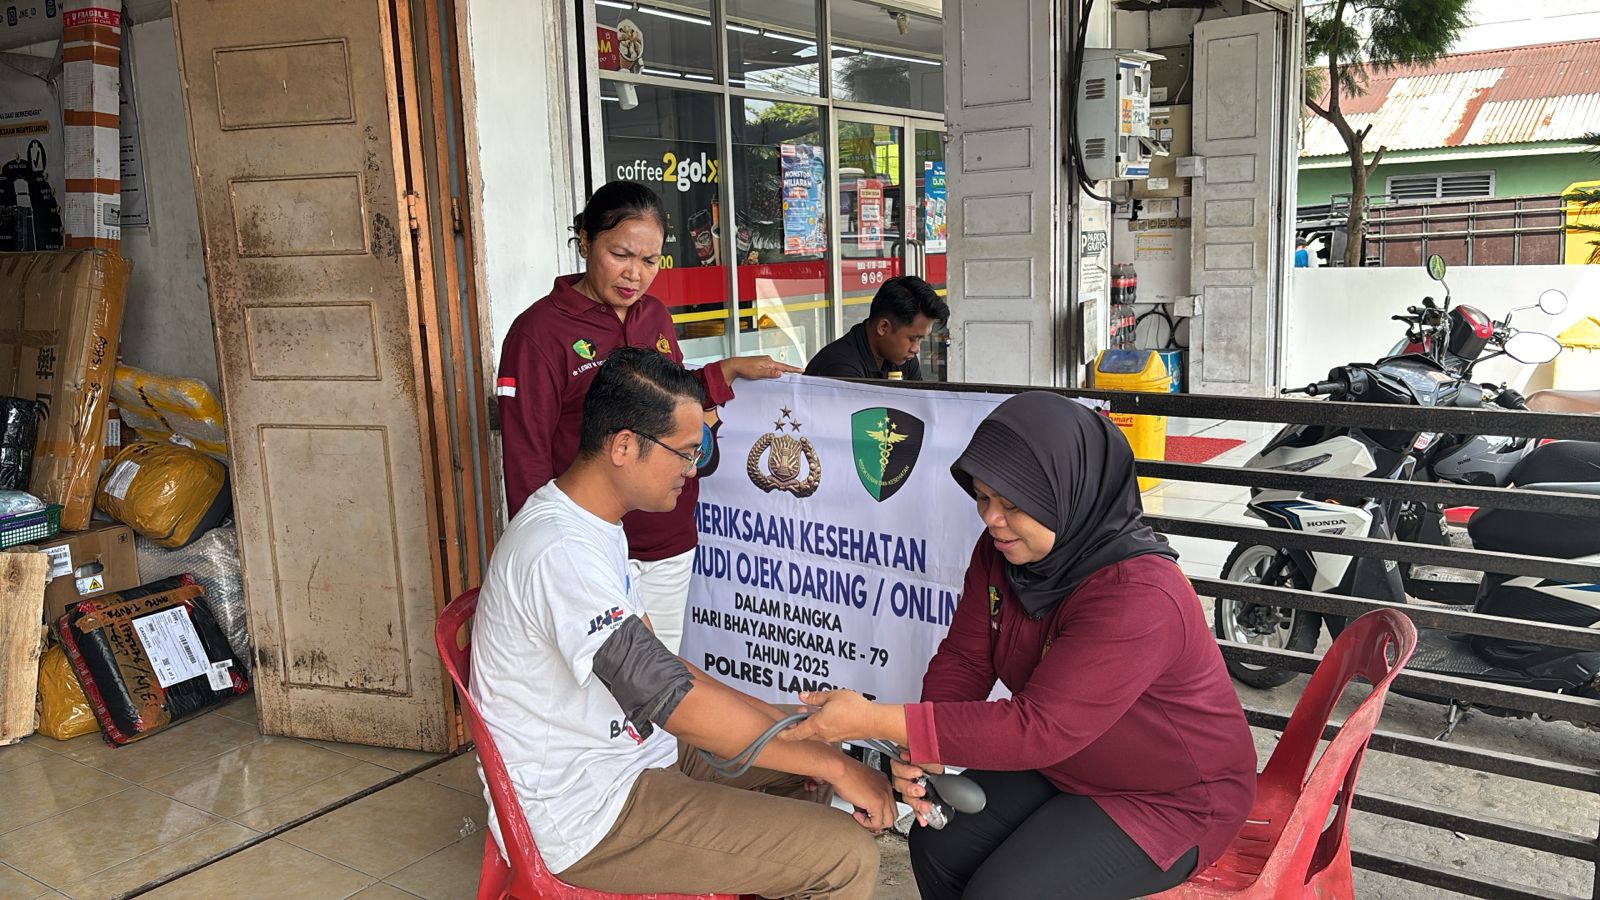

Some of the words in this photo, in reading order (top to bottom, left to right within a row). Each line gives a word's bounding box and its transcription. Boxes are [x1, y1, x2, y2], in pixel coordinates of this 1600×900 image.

[77, 9, 110, 19] FRAGILE
[784, 170, 811, 179] NONSTOP
[1087, 232, 1106, 241] PARKIR
[1087, 241, 1107, 252] GRATIS
[888, 465, 910, 485] KESEHATAN
[1306, 519, 1348, 527] HONDA
[799, 520, 927, 574] KESEHATAN
[736, 552, 784, 592] OJEK
[788, 562, 868, 609] DARING
[872, 578, 886, 617] /
[587, 606, 624, 636] JNE
[735, 592, 780, 618] DALAM
[783, 603, 843, 633] RANGKA
[139, 626, 152, 649] CASHLESS
[692, 606, 721, 628] HARI
[724, 616, 835, 657] BHAYARNGKARA
[838, 640, 857, 662] KE
[869, 647, 889, 668] 79
[745, 641, 790, 669] TAHUN
[794, 652, 829, 678] 2025
[704, 653, 773, 688] POLRES
[778, 672, 877, 702] LANG
